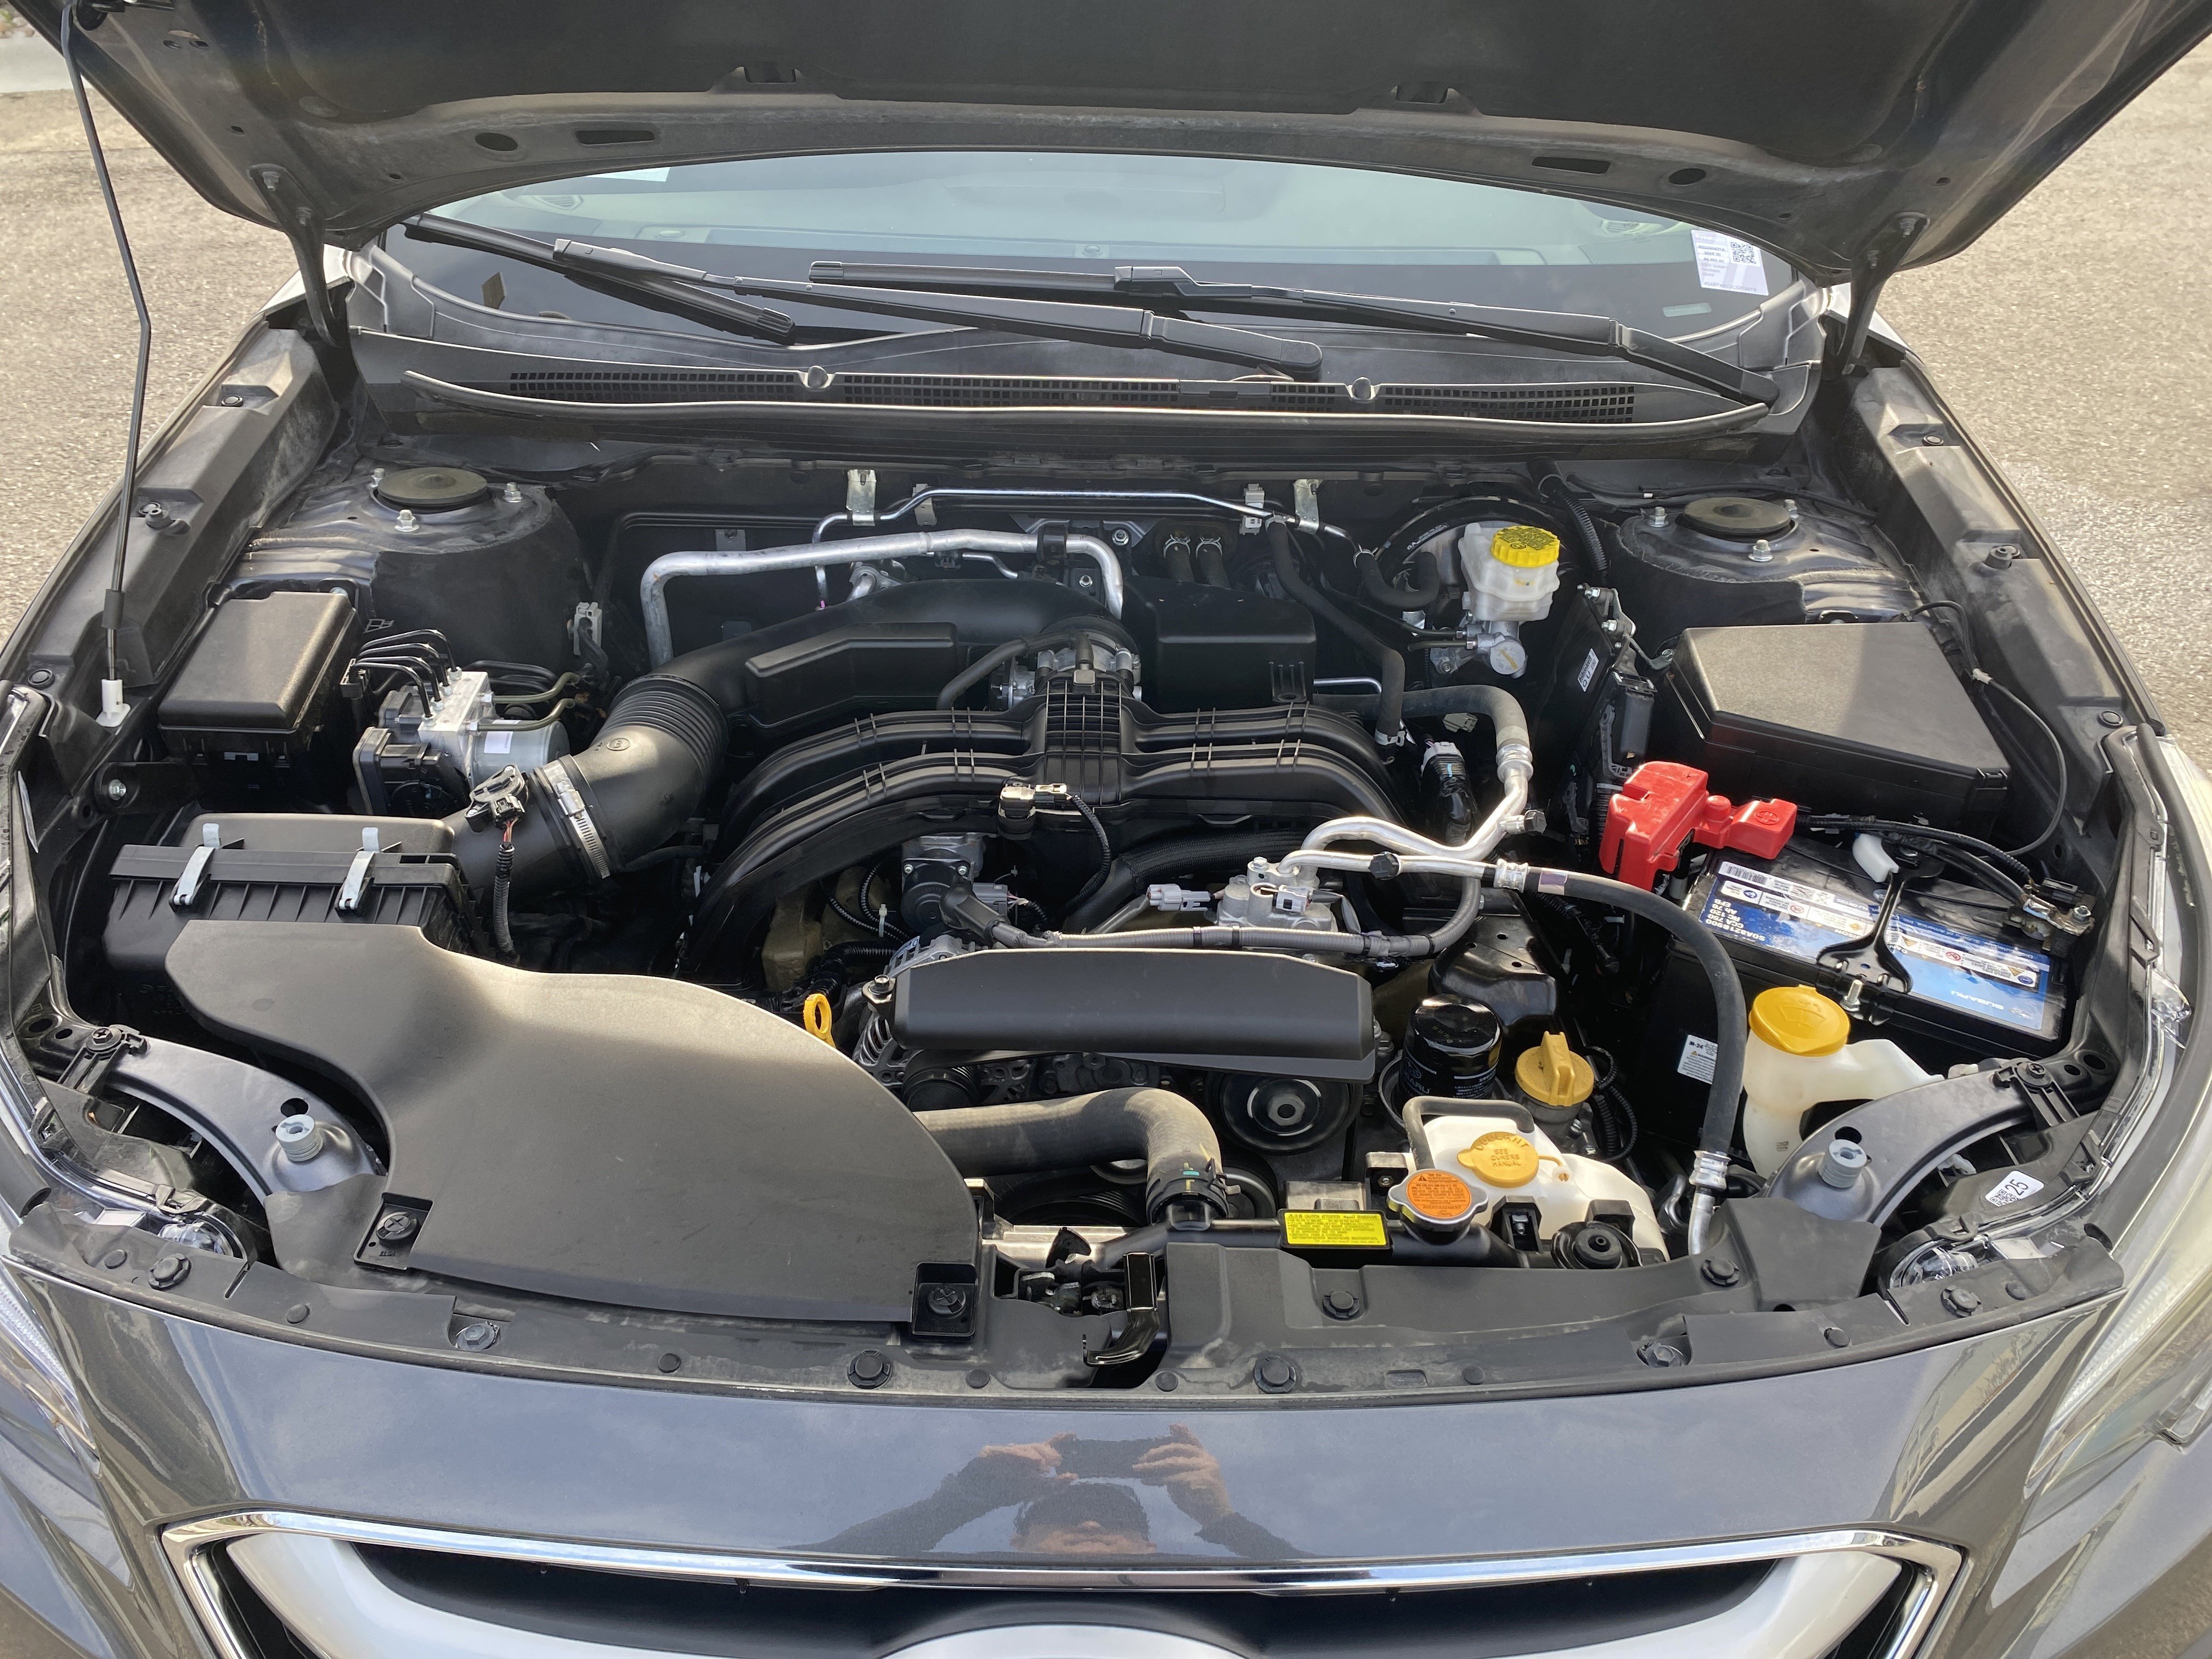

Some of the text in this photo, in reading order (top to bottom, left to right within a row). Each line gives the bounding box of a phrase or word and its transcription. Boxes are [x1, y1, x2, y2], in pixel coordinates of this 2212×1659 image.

[1712, 903, 1737, 915] Ah 76
[1714, 899, 1731, 908] EFB
[1707, 913, 1744, 929] CCA 750
[1709, 909, 1741, 922] RC 120
[1951, 990, 2004, 1011] SUBARU
[1475, 1134, 1530, 1151] COOLANT
[2005, 1178, 2029, 1196] 25
